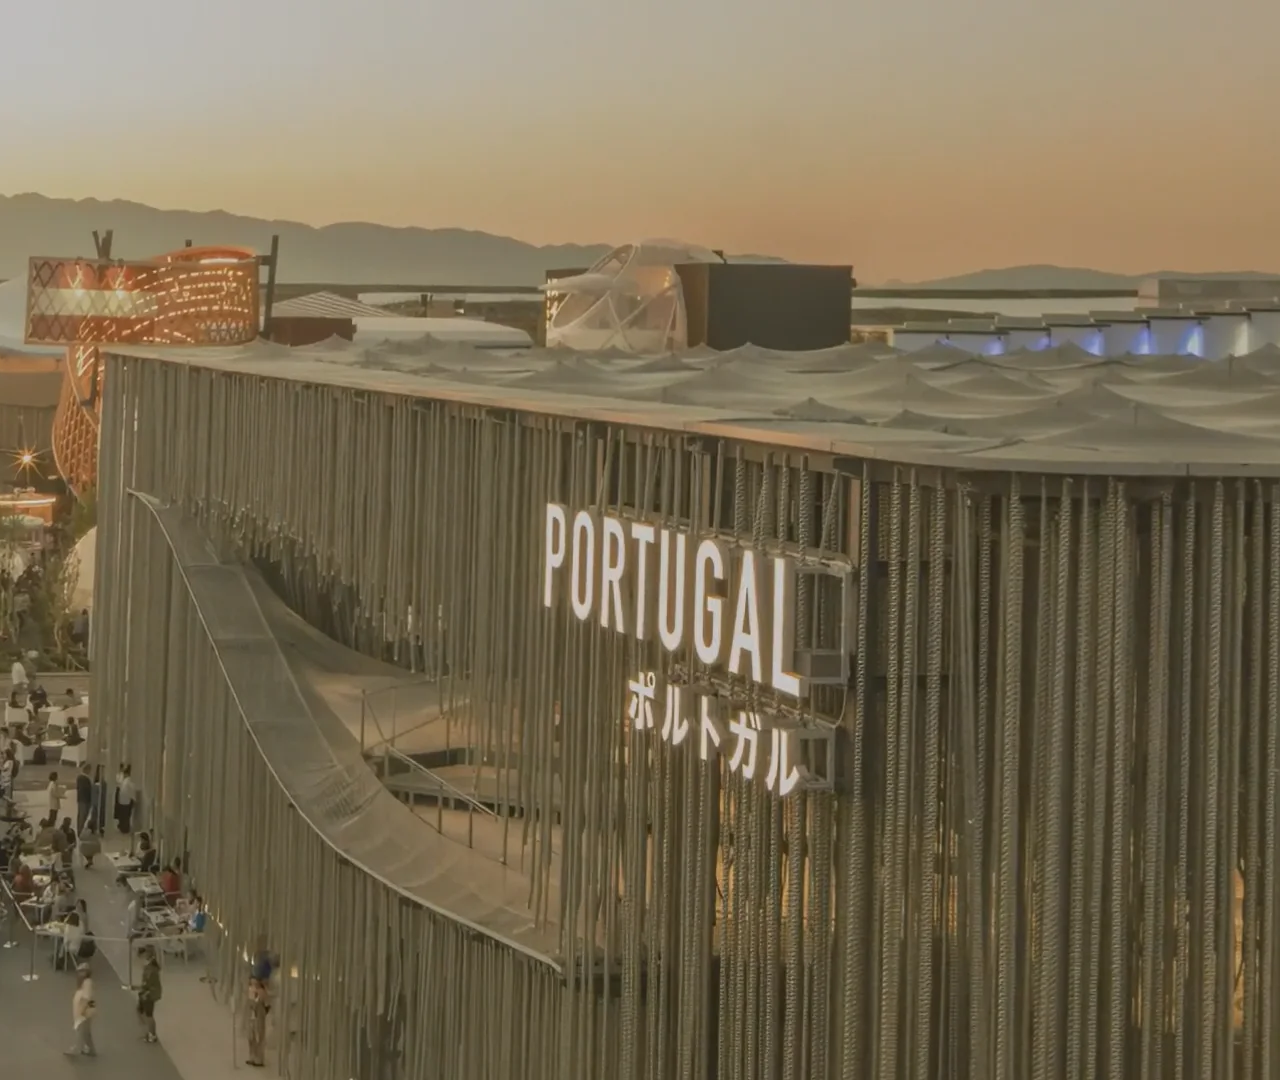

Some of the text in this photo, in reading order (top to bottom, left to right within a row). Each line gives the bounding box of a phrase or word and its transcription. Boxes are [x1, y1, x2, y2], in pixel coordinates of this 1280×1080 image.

[544, 503, 803, 697] PORTUGAL
[628, 671, 801, 796] ポルトガル
